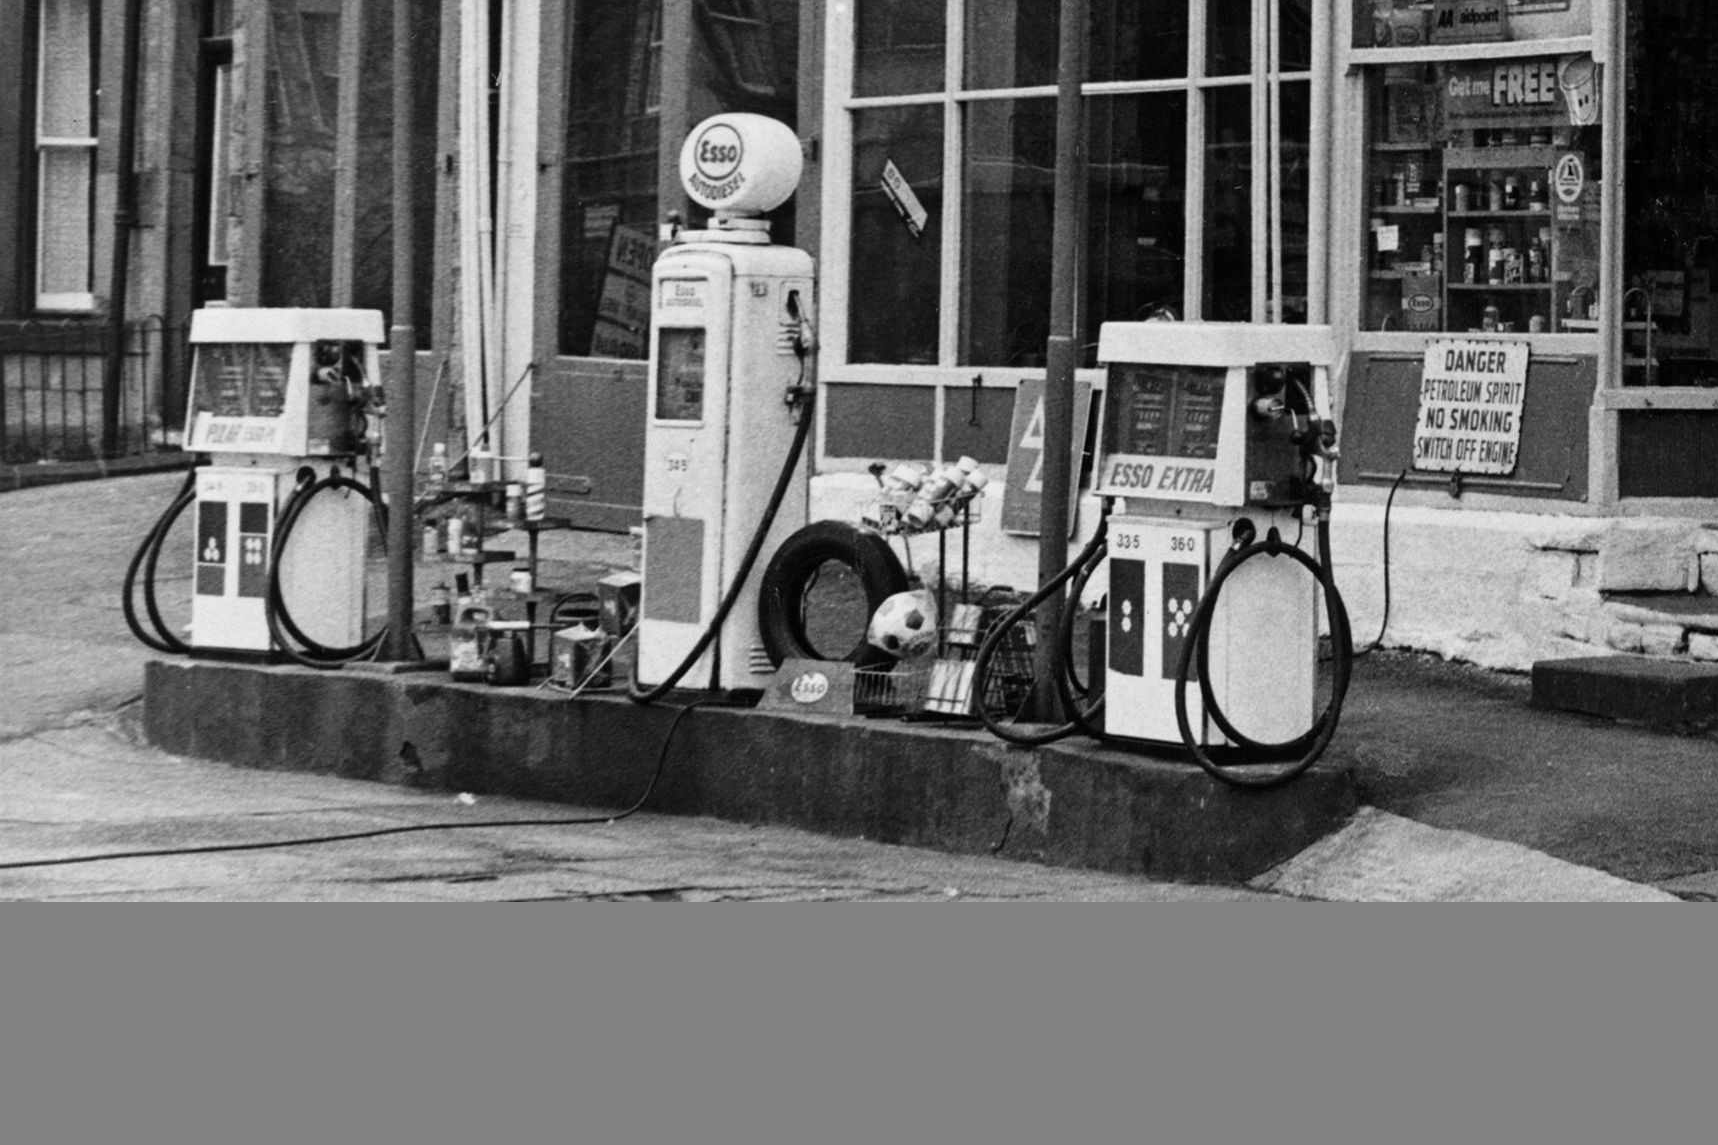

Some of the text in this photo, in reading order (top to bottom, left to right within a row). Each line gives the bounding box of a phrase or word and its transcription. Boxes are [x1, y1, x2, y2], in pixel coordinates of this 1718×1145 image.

[1448, 62, 1555, 105] Get me FREE
[1445, 350, 1506, 374] DANGER
[1423, 378, 1522, 405] PETROLEUM SPIRIT
[1426, 408, 1513, 433] NO SMOKING
[1417, 436, 1516, 465] SWITCH OFF ENGINE
[1109, 462, 1215, 495] ESSO EXTRA
